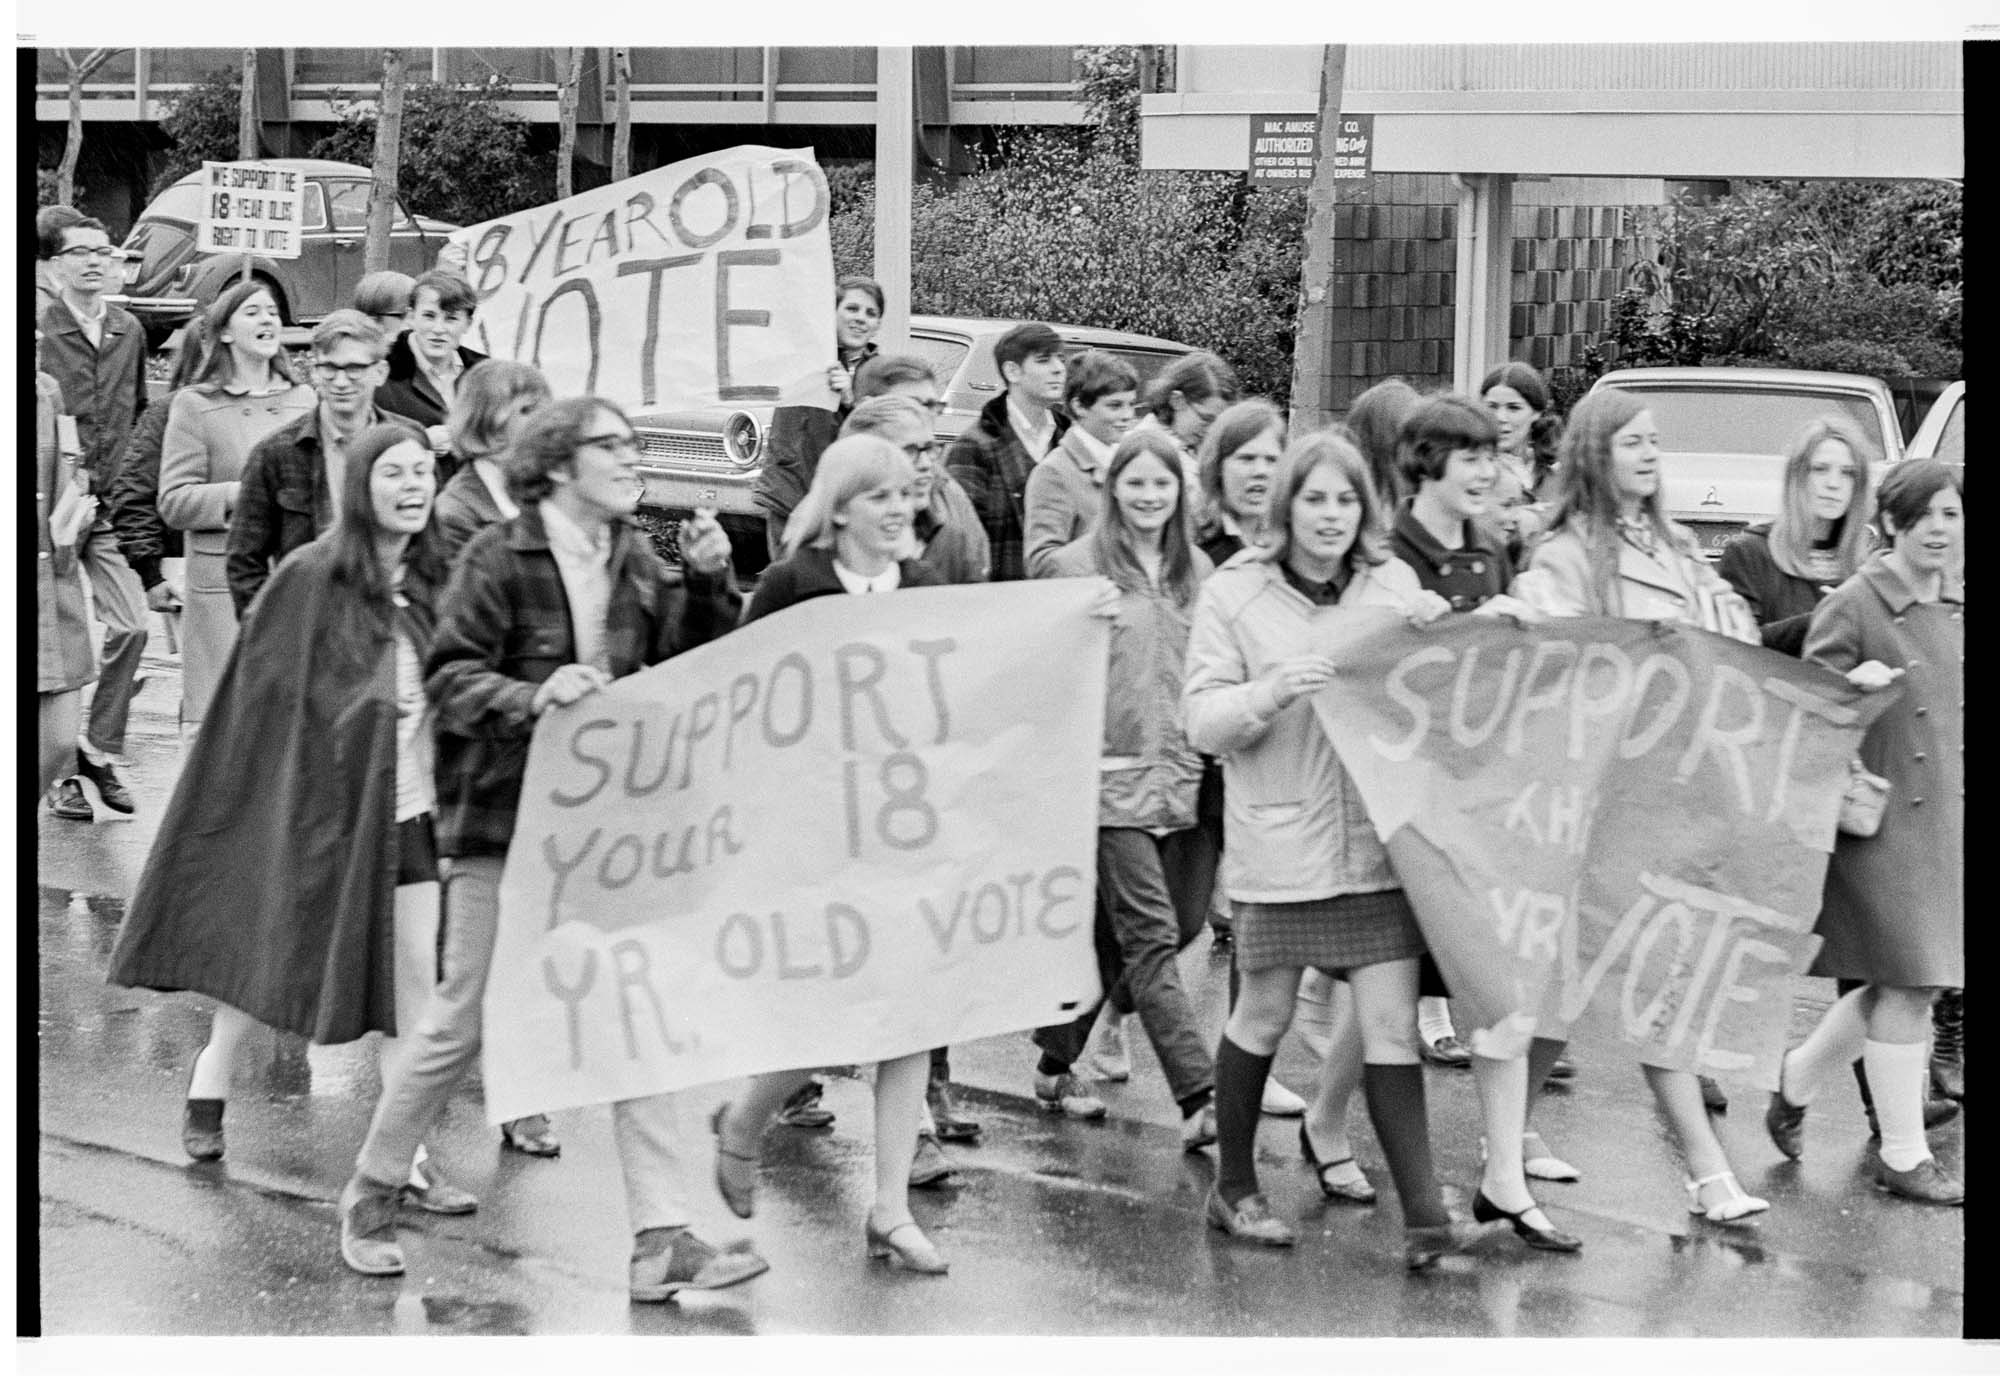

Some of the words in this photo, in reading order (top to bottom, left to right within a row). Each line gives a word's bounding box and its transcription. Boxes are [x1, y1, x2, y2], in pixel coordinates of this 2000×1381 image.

[211, 166, 229, 188] WE
[231, 167, 277, 190] SUPPORT
[279, 171, 297, 193] THE
[1254, 137, 1314, 153] AUTHORIZED
[1254, 156, 1277, 166] OTHER
[1277, 156, 1296, 166] CARS
[1254, 168, 1265, 178] AT
[1334, 168, 1367, 179] EXPENSE
[1263, 121, 1283, 133] MAC
[212, 225, 241, 248] RIGHT
[246, 227, 258, 249] TO
[263, 229, 290, 251] VOTE
[518, 191, 673, 284] YEAR
[668, 160, 830, 249] OLD
[478, 247, 783, 407] VOTE
[548, 636, 959, 810] SUPPORT
[1367, 639, 1860, 824] SUPPORT
[541, 804, 746, 931] YOUR
[842, 751, 940, 860] 18
[714, 901, 873, 981] OLD
[918, 864, 1086, 954] VOTE
[1559, 870, 1802, 1071] VOTE
